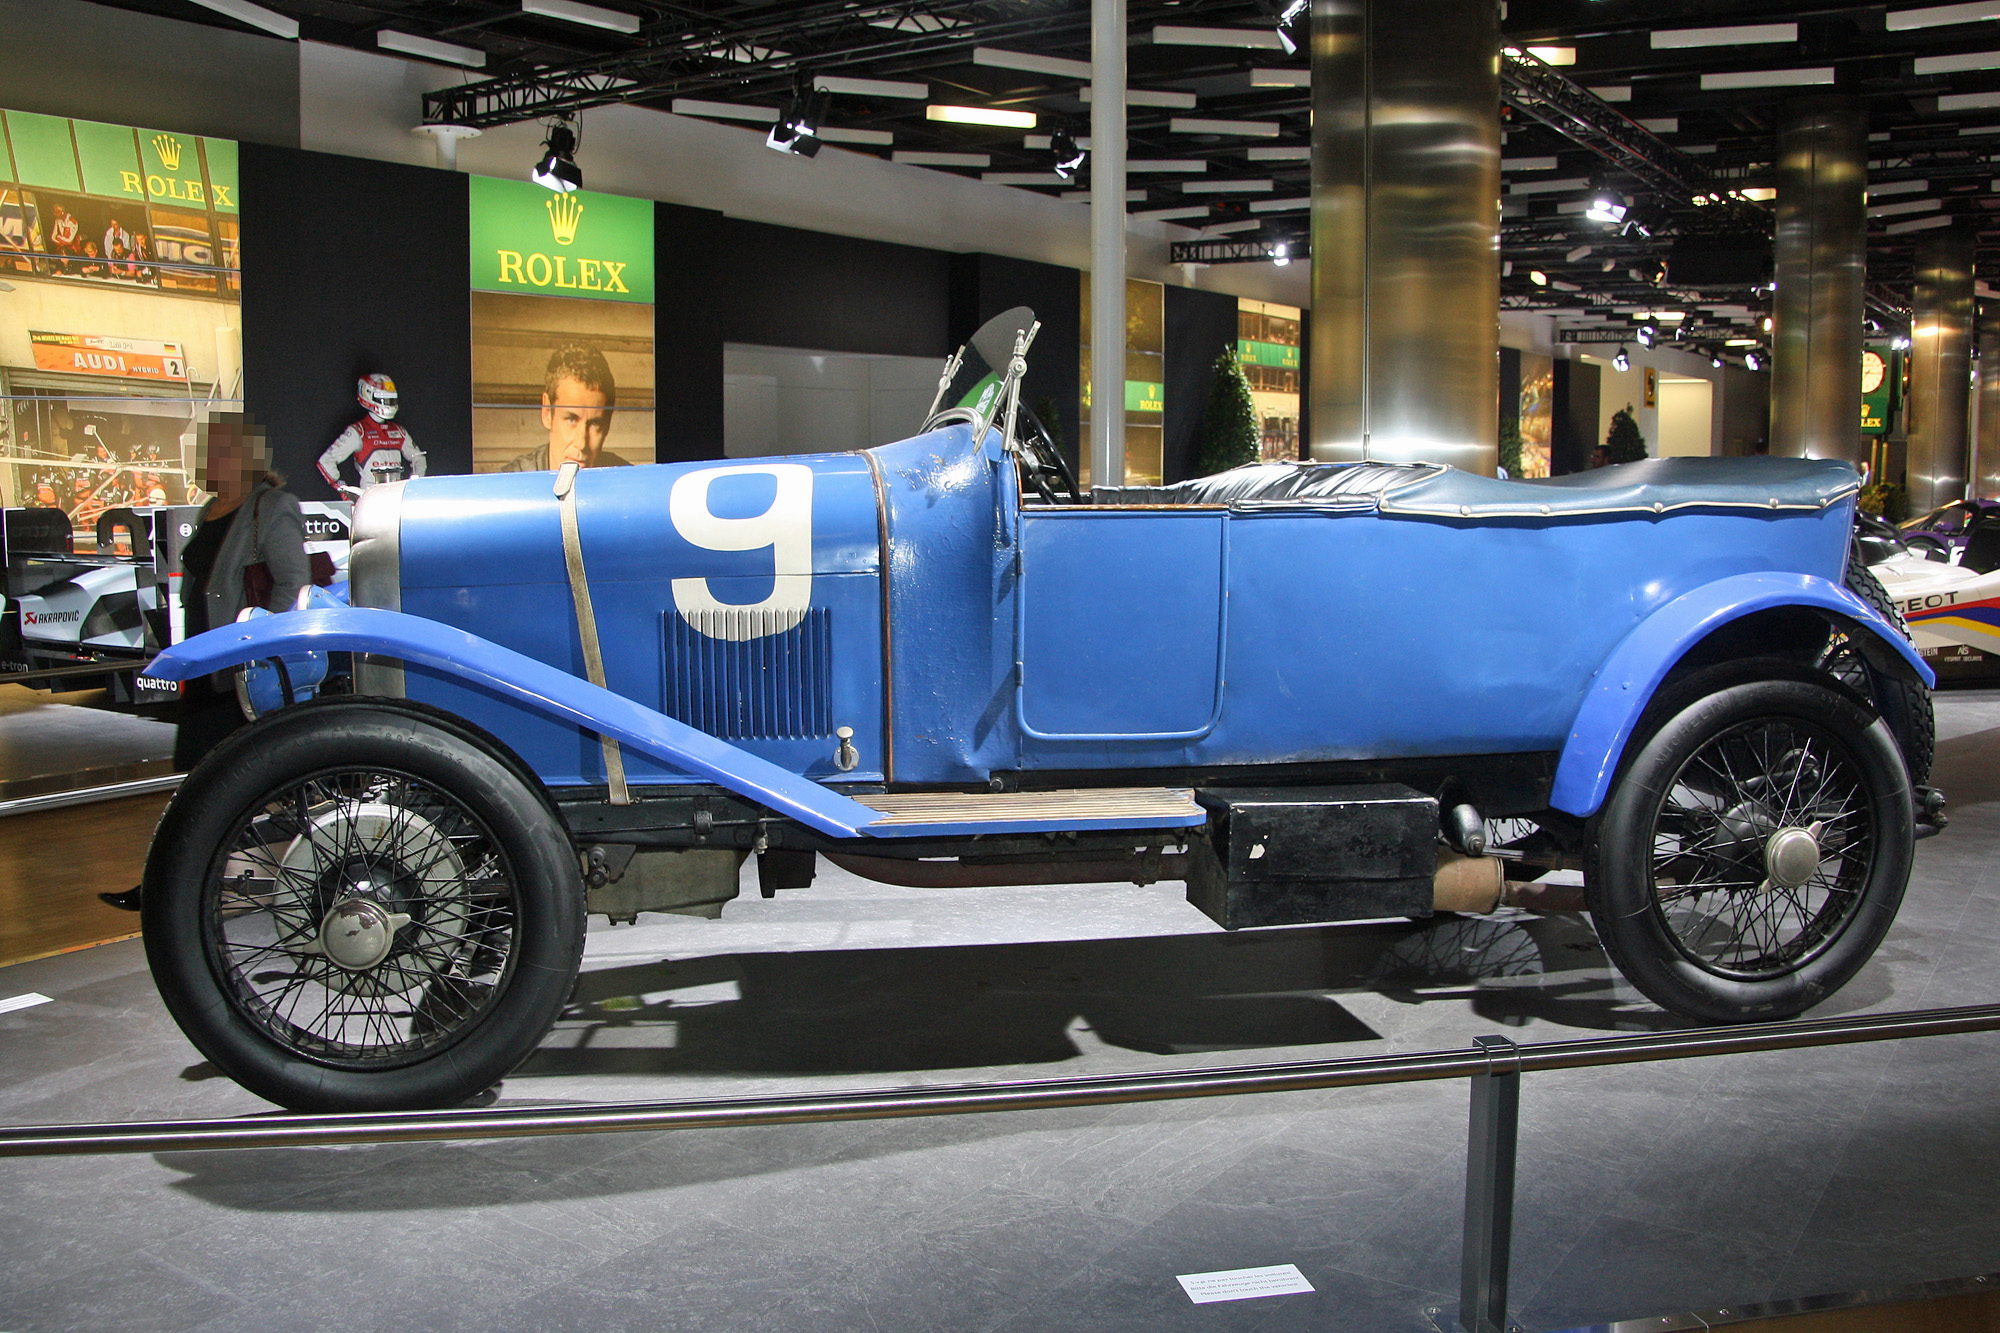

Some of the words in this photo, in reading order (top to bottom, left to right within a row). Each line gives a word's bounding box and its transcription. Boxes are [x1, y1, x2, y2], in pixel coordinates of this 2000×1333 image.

[120, 170, 235, 207] ROLEX
[497, 249, 630, 293] ROLEX
[74, 352, 127, 372] AUDI
[132, 366, 160, 374] HYBRID
[170, 360, 180, 375] 2
[1139, 399, 1164, 411] ROLEX
[1861, 417, 1882, 428] LEX
[304, 520, 340, 534] ttro
[669, 463, 814, 642] 9
[1, 660, 29, 673] e-tron
[136, 676, 178, 692] quattro
